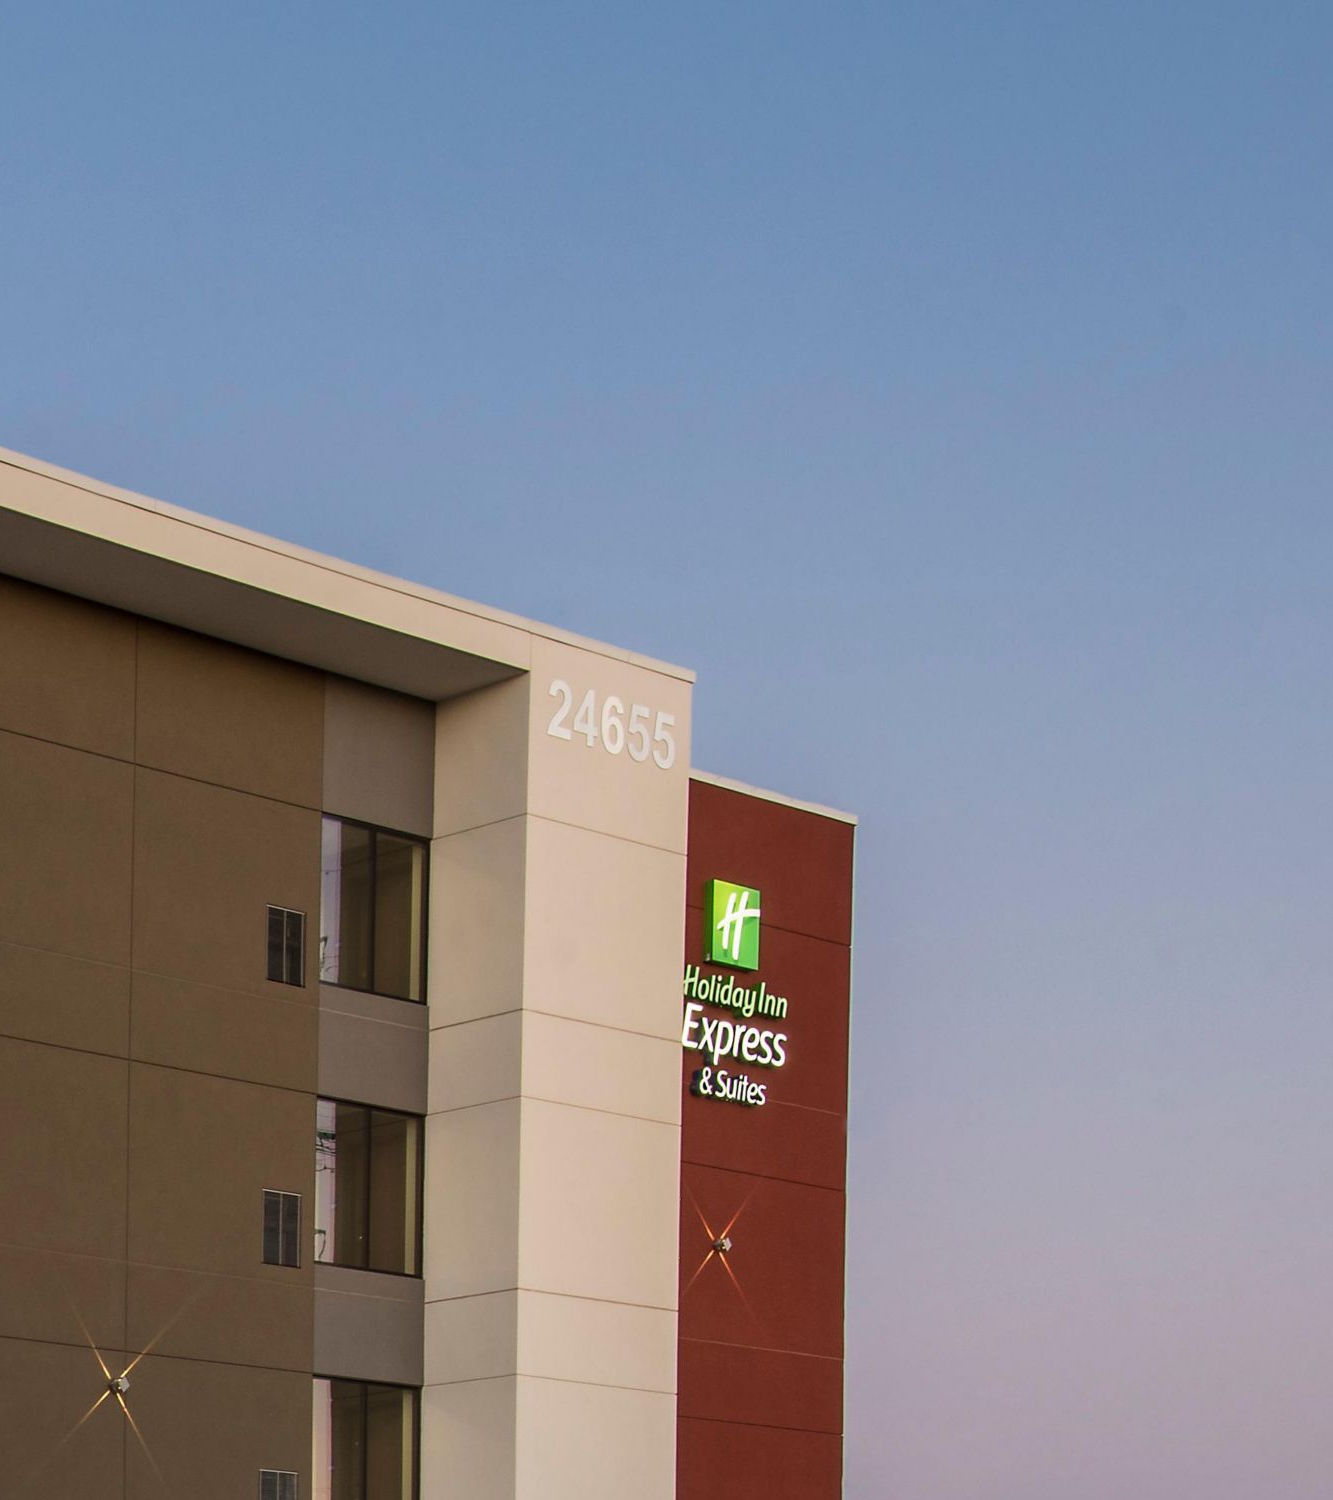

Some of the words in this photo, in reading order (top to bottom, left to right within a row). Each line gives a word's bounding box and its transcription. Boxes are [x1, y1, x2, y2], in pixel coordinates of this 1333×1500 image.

[547, 679, 676, 770] 24655
[683, 963, 757, 1018] Holiday
[758, 981, 788, 1018] Inn
[681, 1002, 788, 1068] Express
[699, 1066, 713, 1095] &
[715, 1069, 767, 1106] Suites
